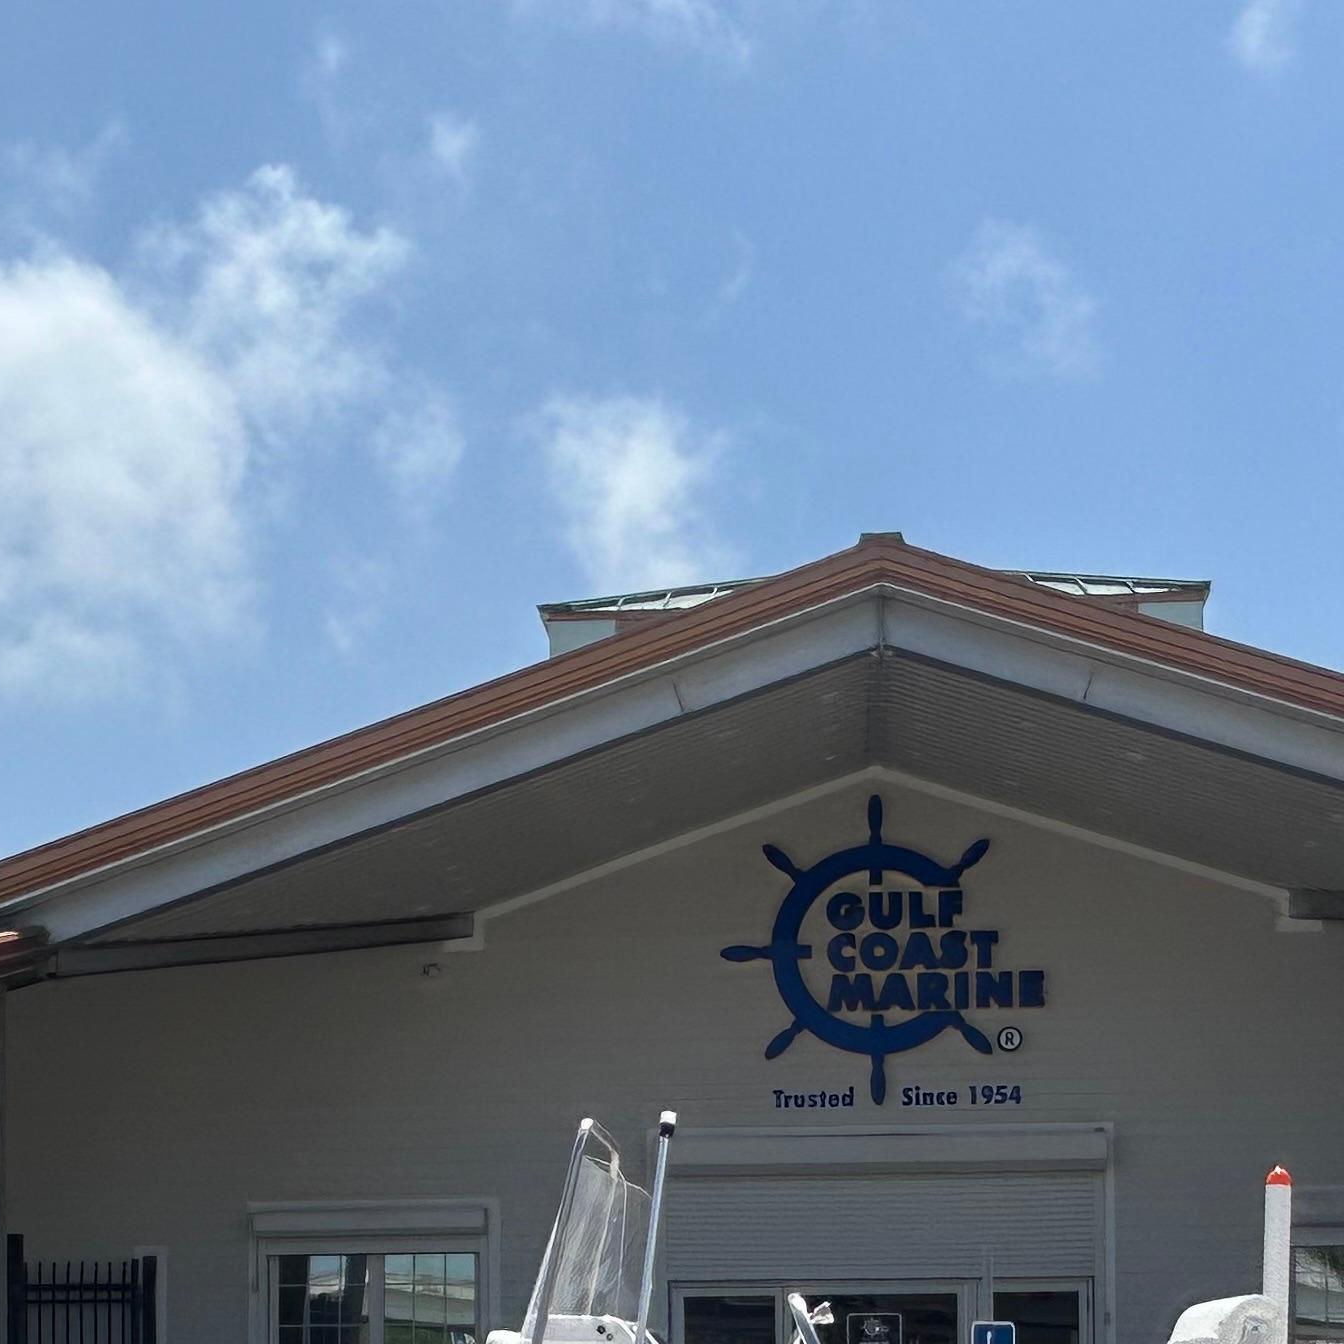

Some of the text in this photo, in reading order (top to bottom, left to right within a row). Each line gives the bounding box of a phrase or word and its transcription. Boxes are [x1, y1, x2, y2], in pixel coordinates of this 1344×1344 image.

[826, 890, 964, 931] GULF
[826, 930, 999, 971] COAST
[827, 970, 1046, 1012] MARINE
[772, 1085, 1022, 1108] Trusted Since 1954
